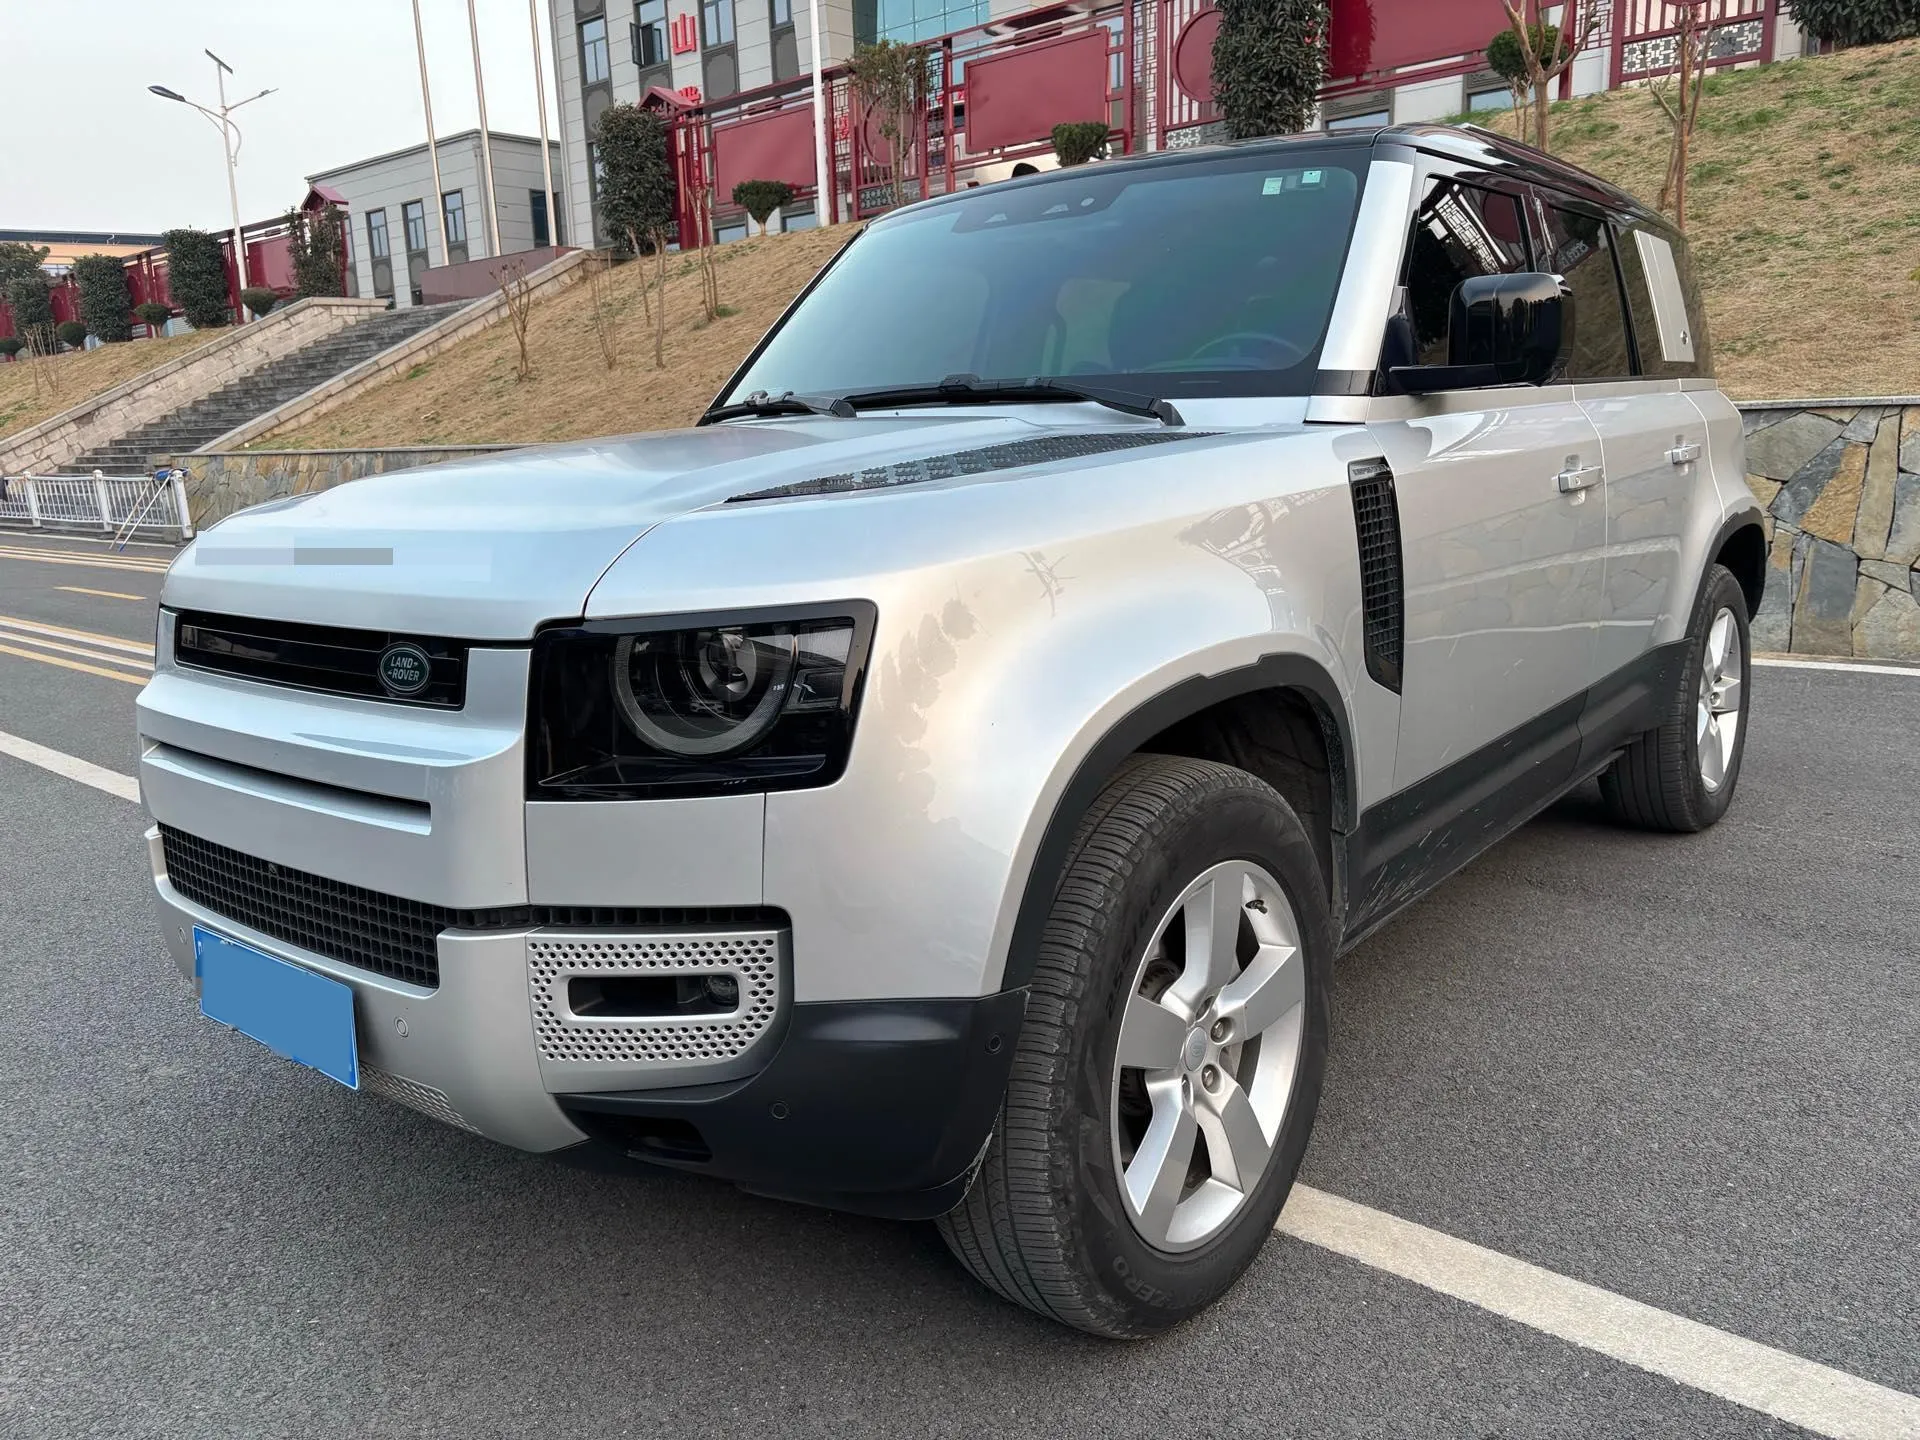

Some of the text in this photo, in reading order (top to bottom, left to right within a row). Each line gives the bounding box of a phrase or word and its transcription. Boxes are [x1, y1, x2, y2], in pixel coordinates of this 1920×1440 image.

[391, 656, 413, 668] LAND
[392, 668, 420, 681] ROVER
[1112, 1255, 1171, 1308] ZERO
